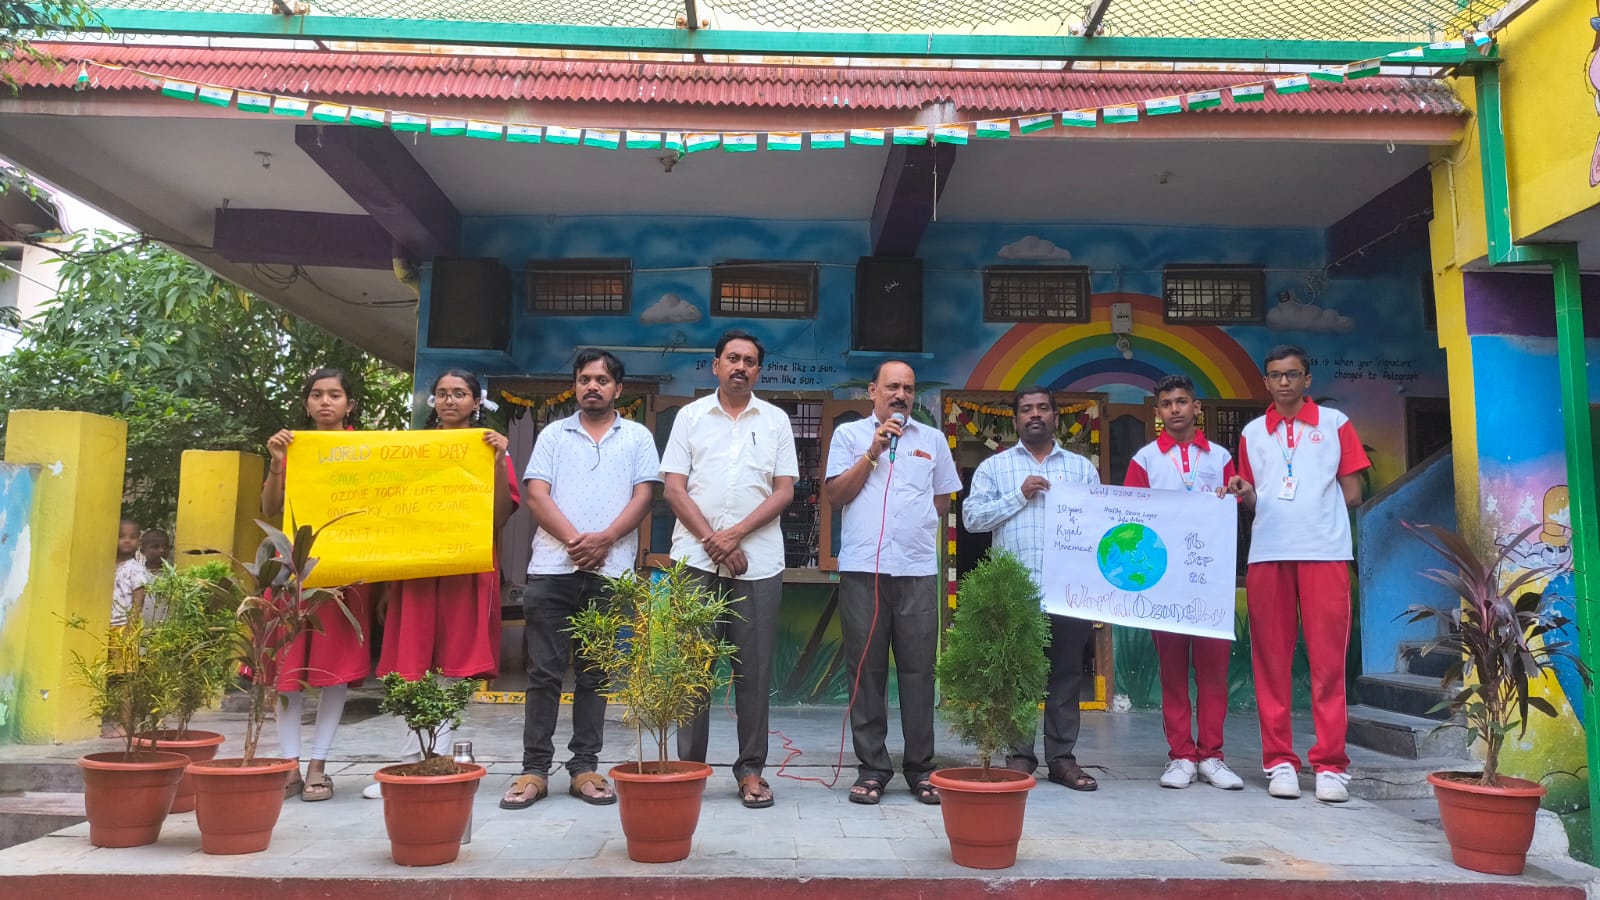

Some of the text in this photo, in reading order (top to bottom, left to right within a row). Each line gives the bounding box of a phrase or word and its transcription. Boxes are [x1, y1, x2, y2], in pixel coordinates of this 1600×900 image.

[767, 361, 789, 372] shine
[792, 361, 807, 373] like
[782, 374, 797, 384] like
[318, 442, 470, 464] WORLD OZONE DAY
[330, 487, 369, 503] OZONE
[414, 485, 437, 497] LIFE
[393, 503, 422, 514] ONE
[1057, 504, 1067, 514] 10
